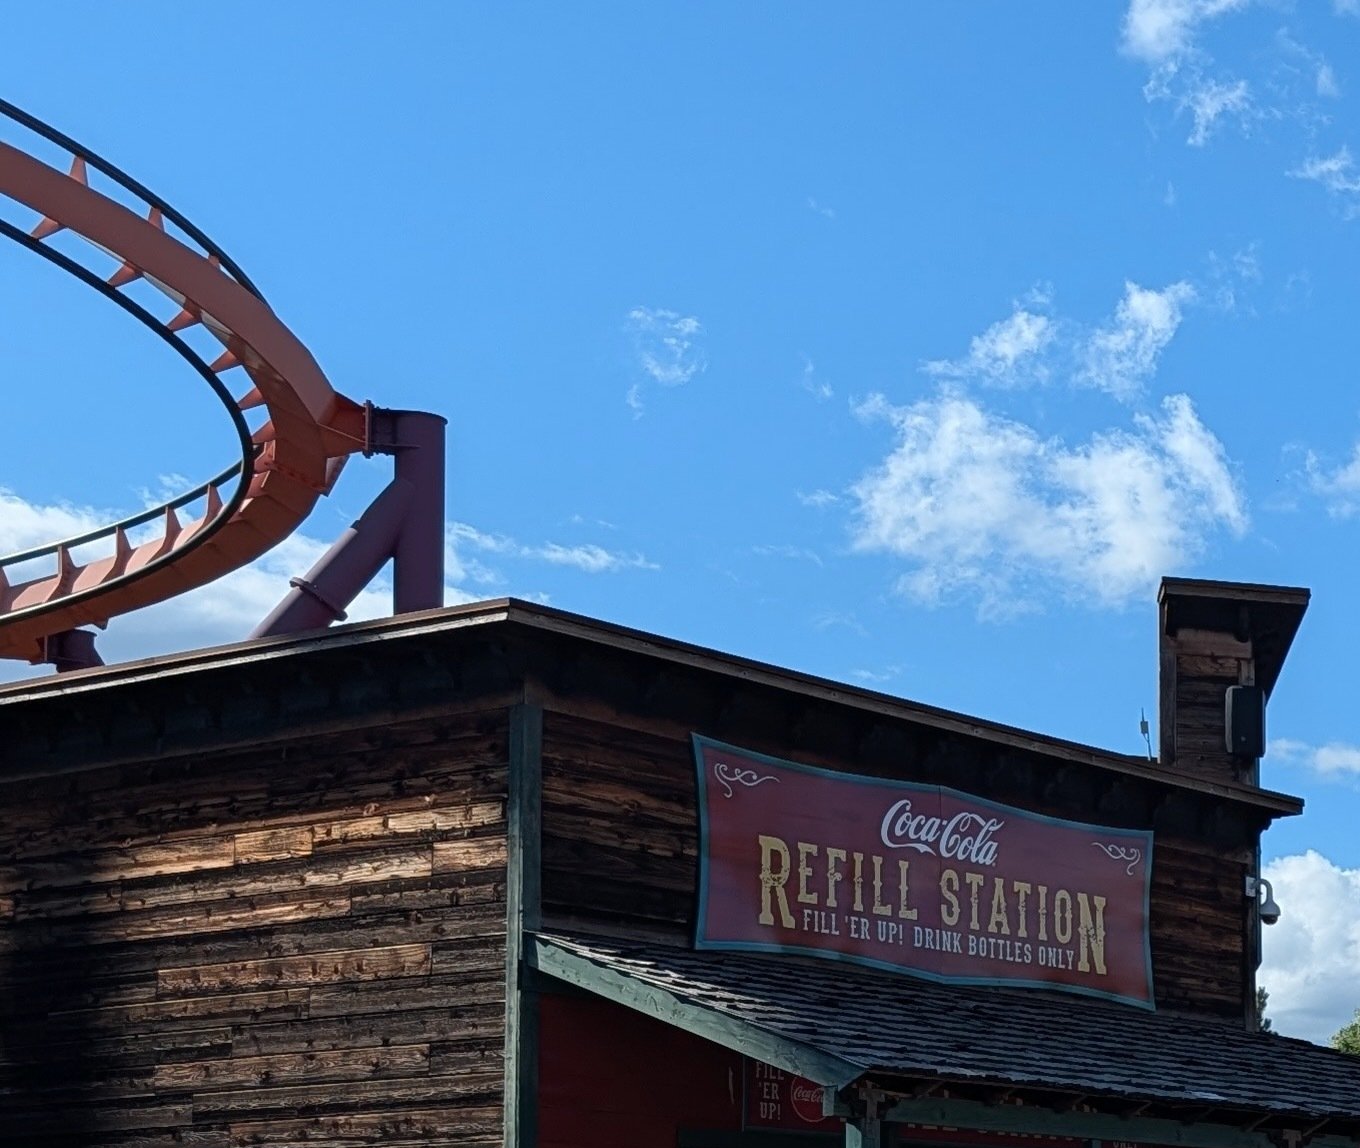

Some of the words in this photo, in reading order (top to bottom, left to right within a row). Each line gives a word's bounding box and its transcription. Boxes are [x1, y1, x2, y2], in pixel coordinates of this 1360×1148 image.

[881, 800, 1004, 865] Coca-Cola
[758, 835, 918, 929] REFILL
[940, 869, 1106, 975] STATION
[804, 910, 840, 936] FILL
[845, 915, 870, 941] 'ER
[877, 921, 904, 946] UP!
[914, 926, 962, 953] DRINK
[968, 934, 1032, 964] BOTTLES
[1038, 946, 1074, 970] ONLY
[759, 1101, 781, 1121] UP!
